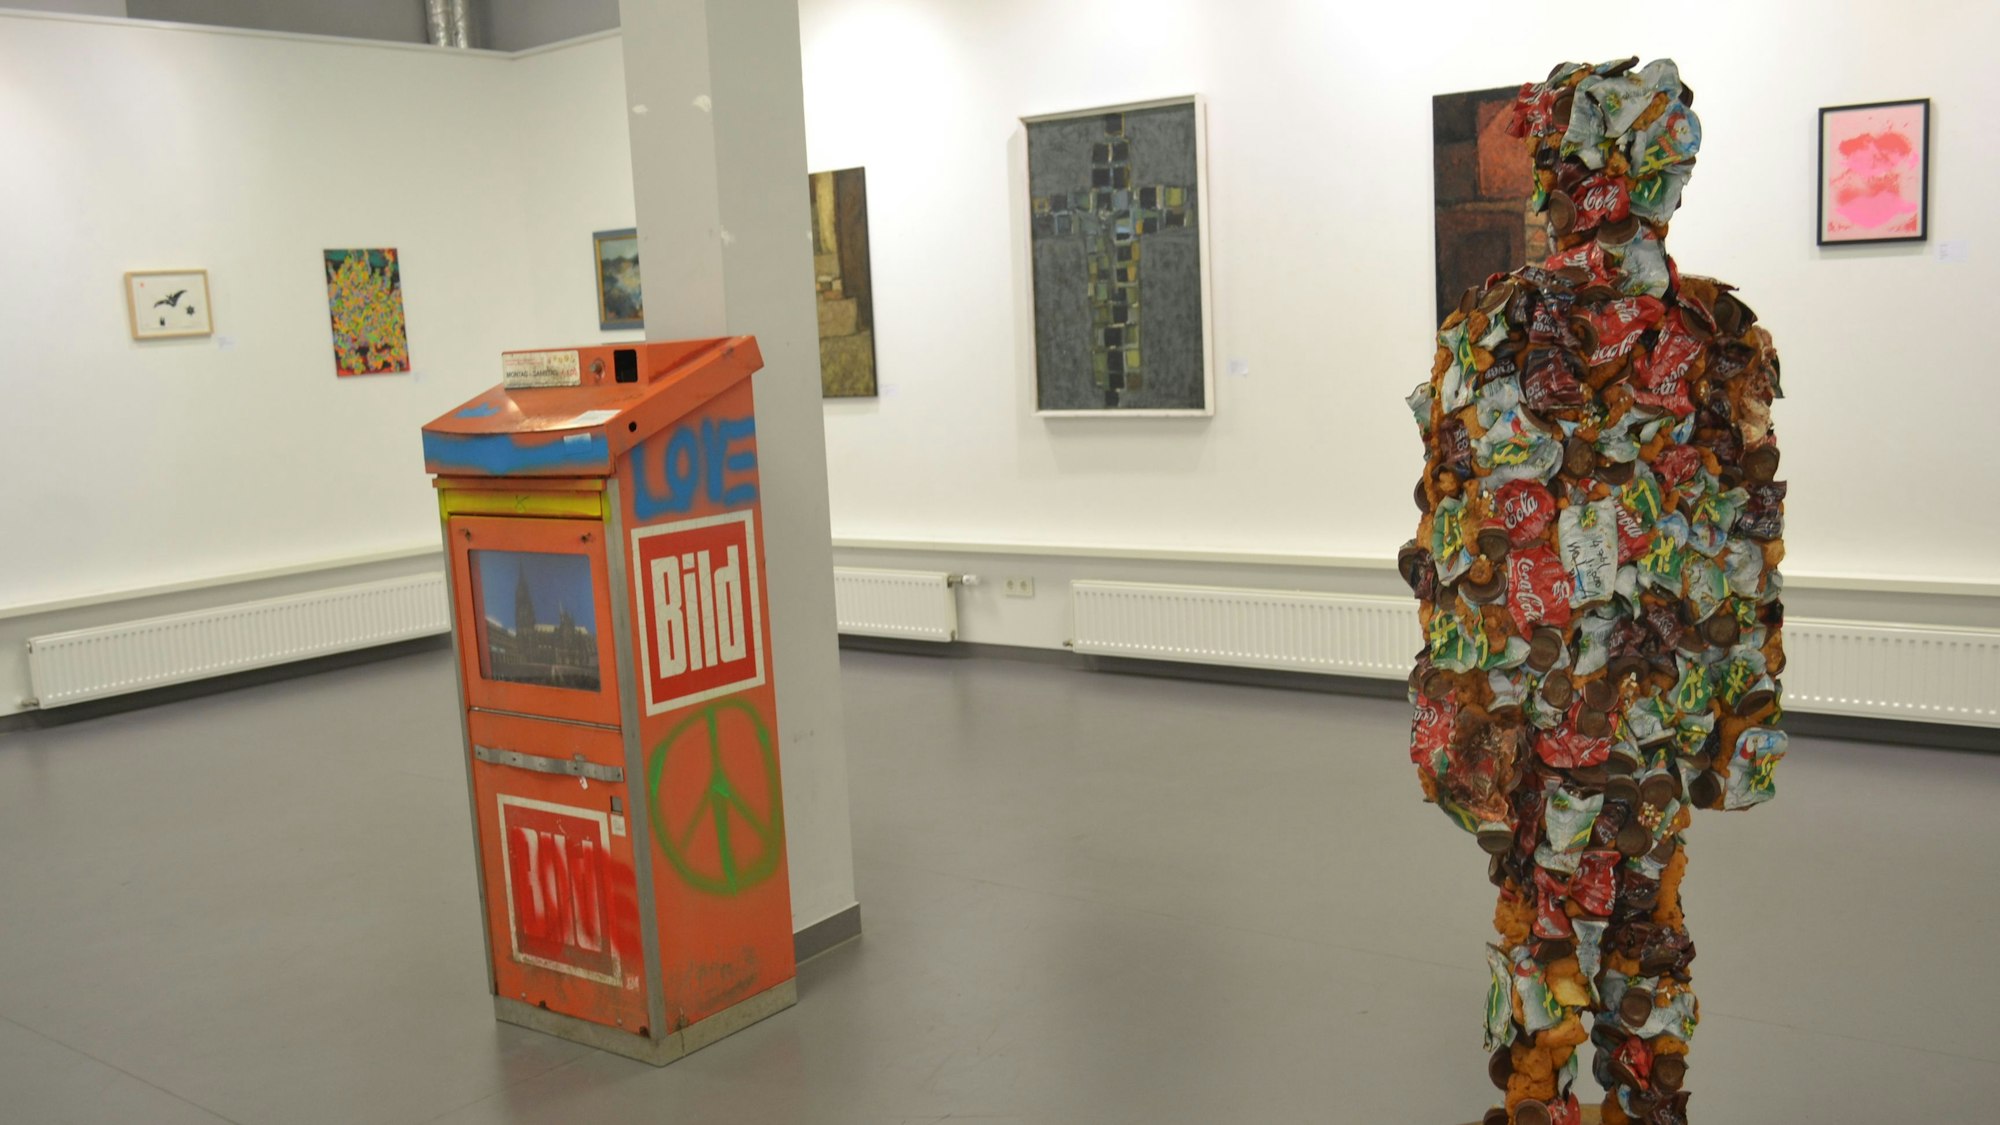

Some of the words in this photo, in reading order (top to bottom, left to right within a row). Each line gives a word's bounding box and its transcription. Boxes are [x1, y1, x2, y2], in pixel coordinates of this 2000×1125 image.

[630, 416, 756, 521] LOVE
[1504, 489, 1539, 529] Cola
[651, 544, 747, 680] Bild
